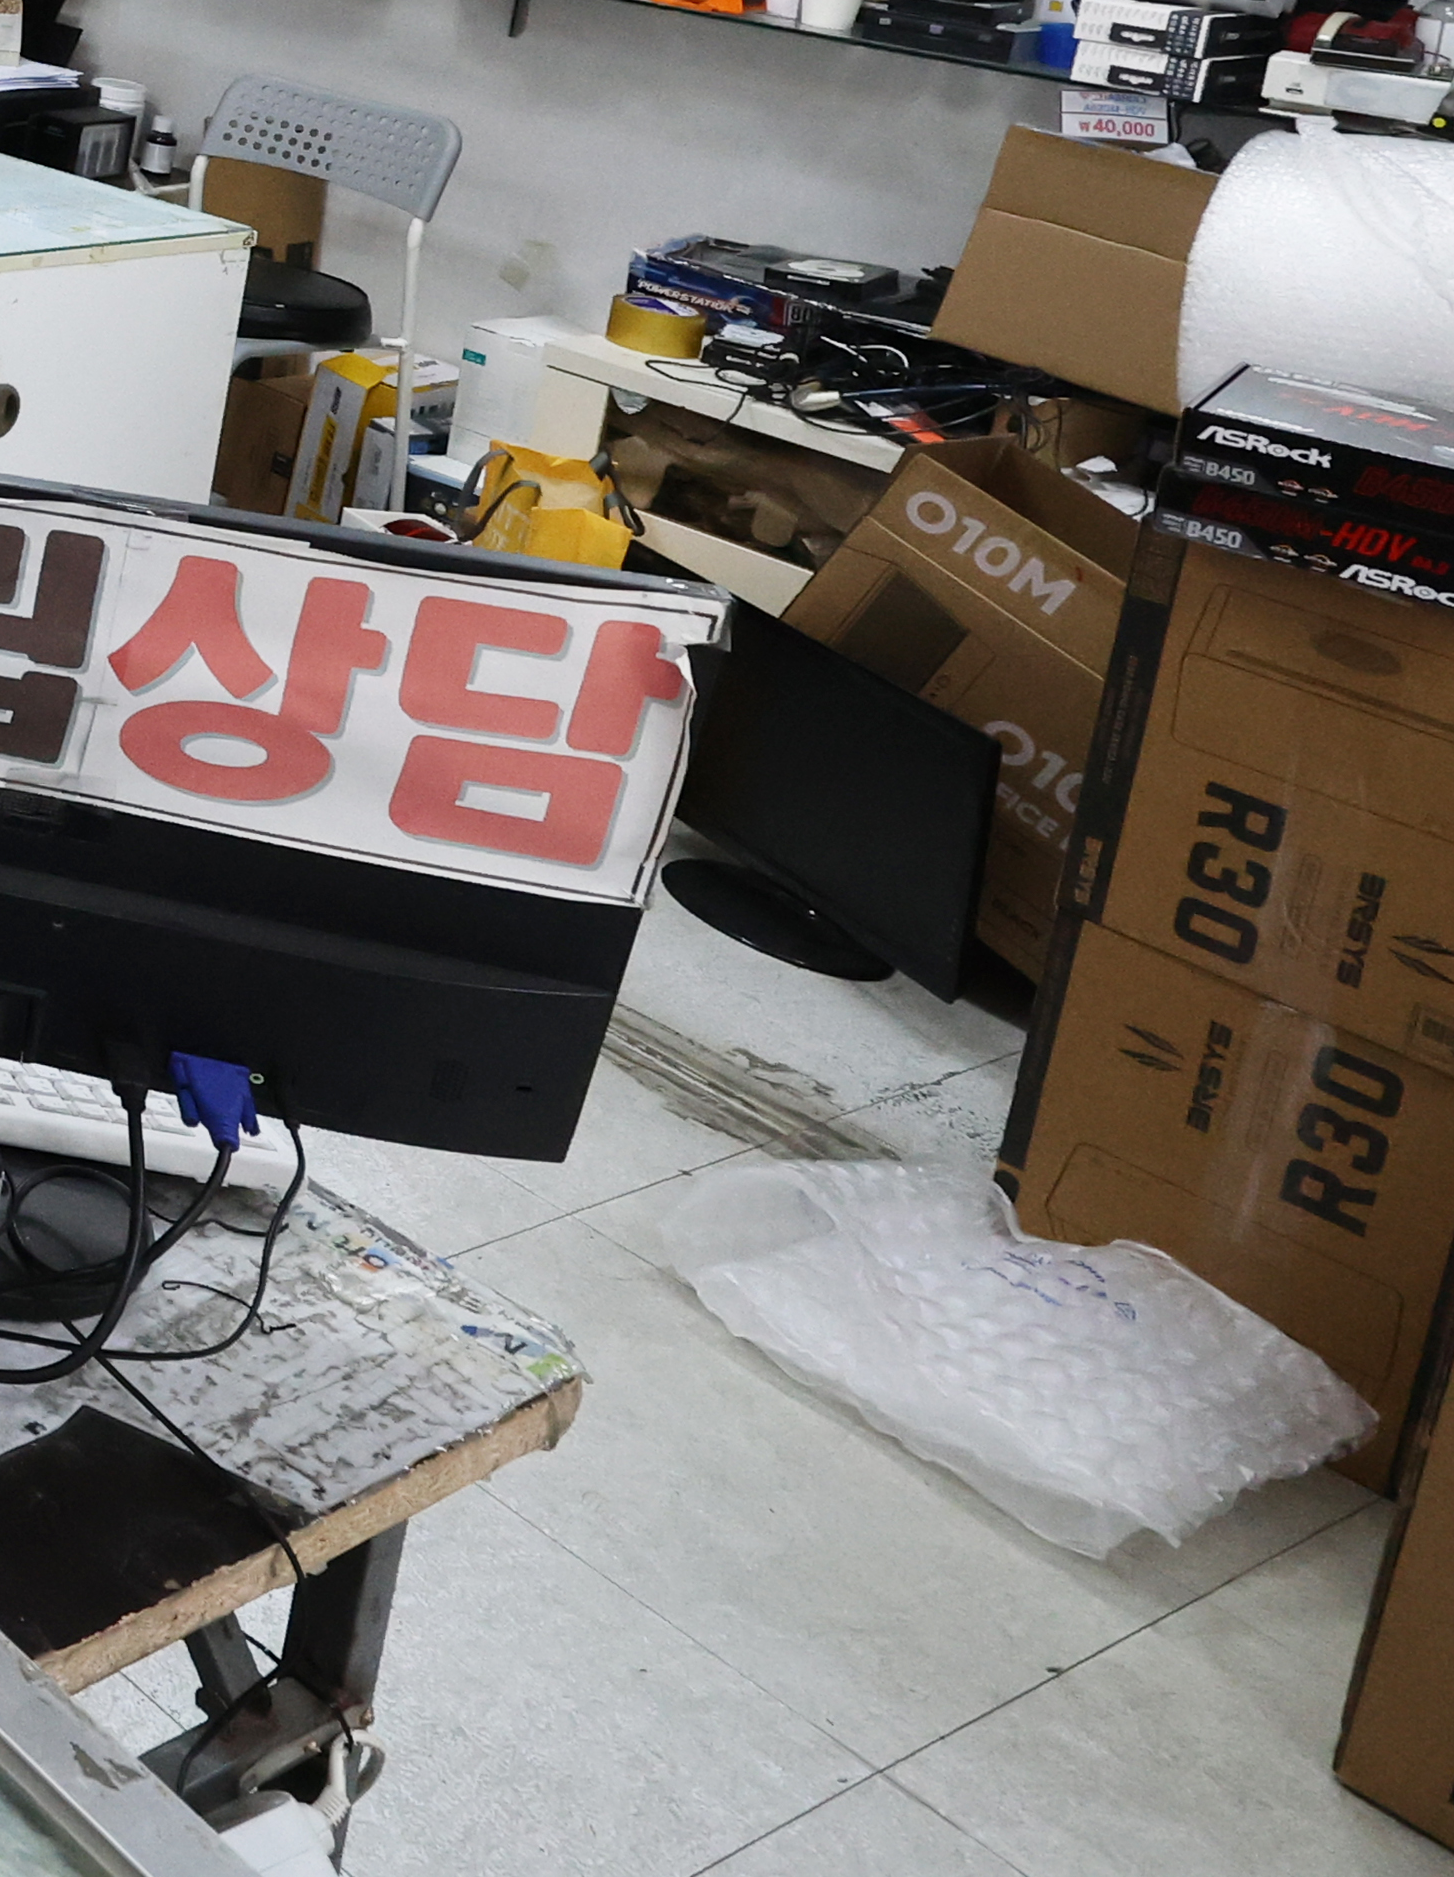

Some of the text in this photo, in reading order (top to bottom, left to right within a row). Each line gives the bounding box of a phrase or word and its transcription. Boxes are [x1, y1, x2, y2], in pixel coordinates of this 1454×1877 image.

[1079, 119, 1155, 138] ₩40,000
[1197, 425, 1333, 469] ASRock
[1206, 461, 1255, 485] B450
[1186, 521, 1242, 549] B450
[1339, 564, 1454, 607] ASRoc
[1173, 780, 1289, 966] R30
[1278, 1044, 1405, 1238] R30
